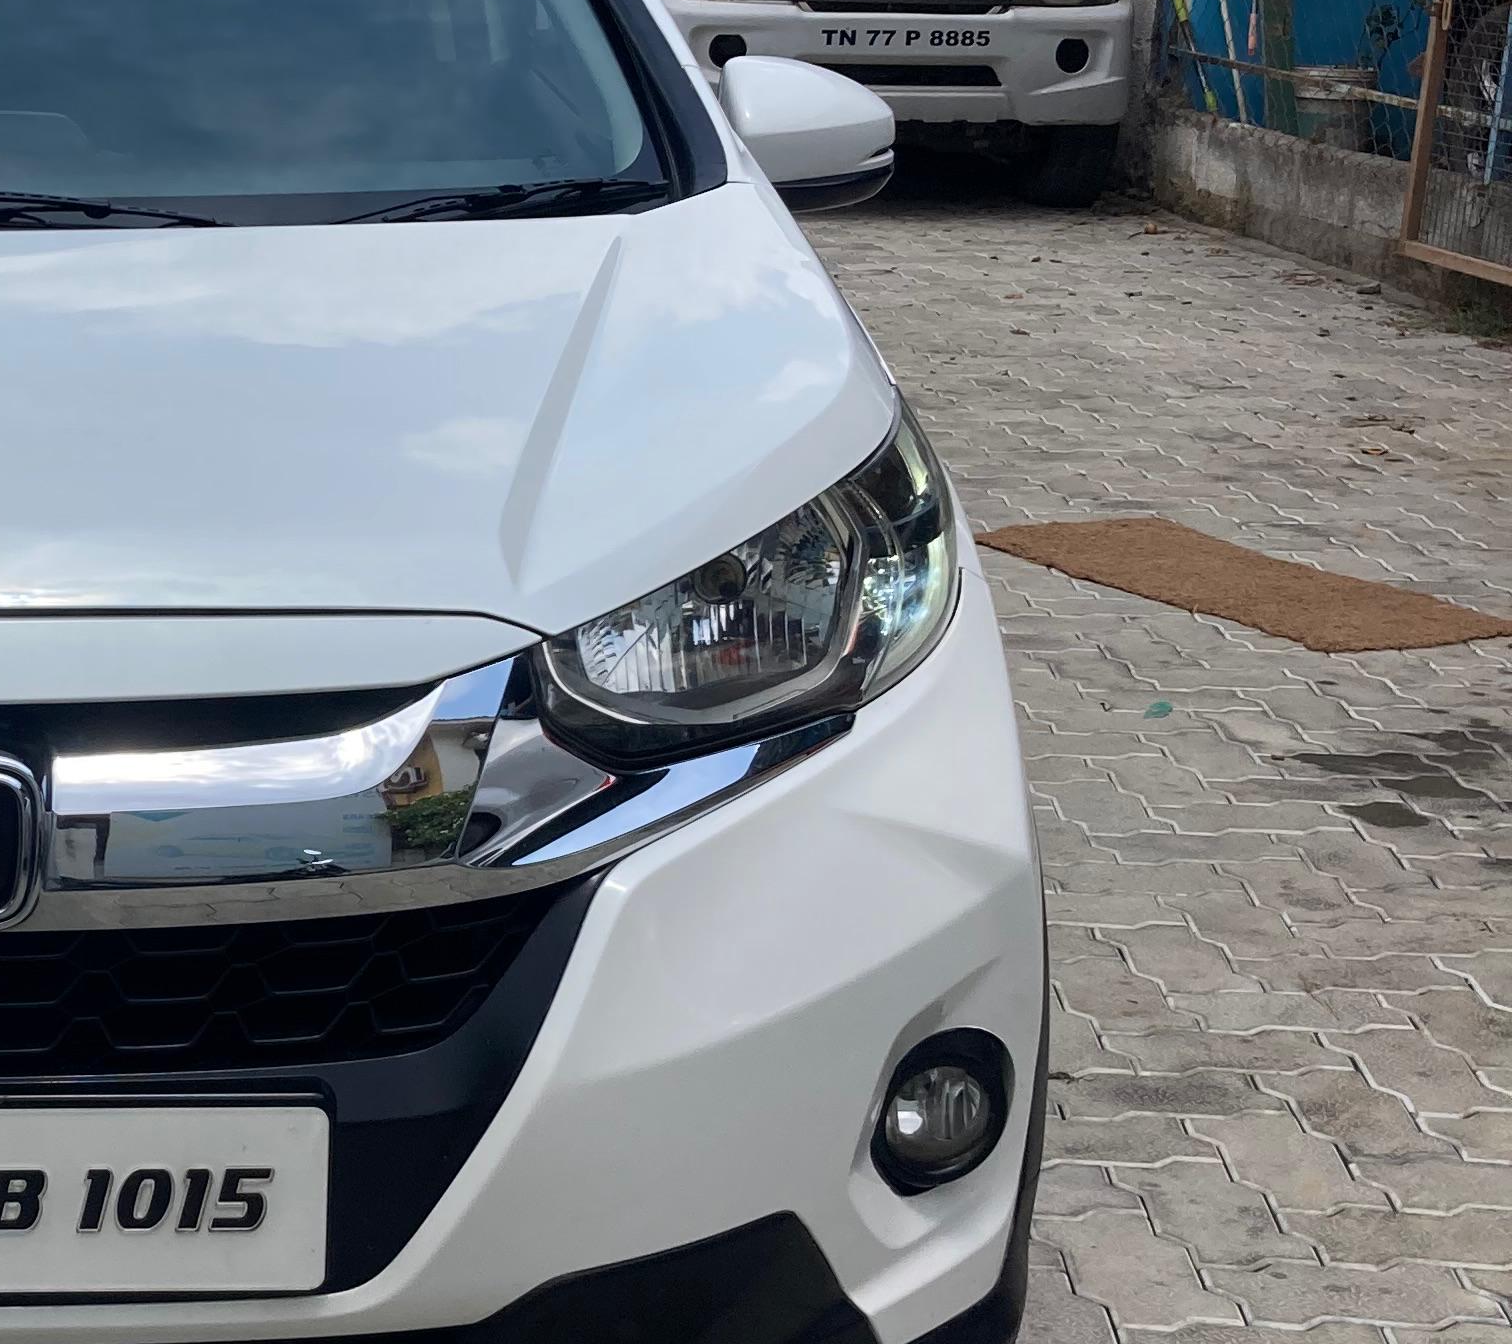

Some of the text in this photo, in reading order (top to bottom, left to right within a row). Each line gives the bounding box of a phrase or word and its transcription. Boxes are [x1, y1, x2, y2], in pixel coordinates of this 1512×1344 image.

[821, 29, 991, 47] TN 77 P 8885
[74, 1166, 276, 1235] 1015
